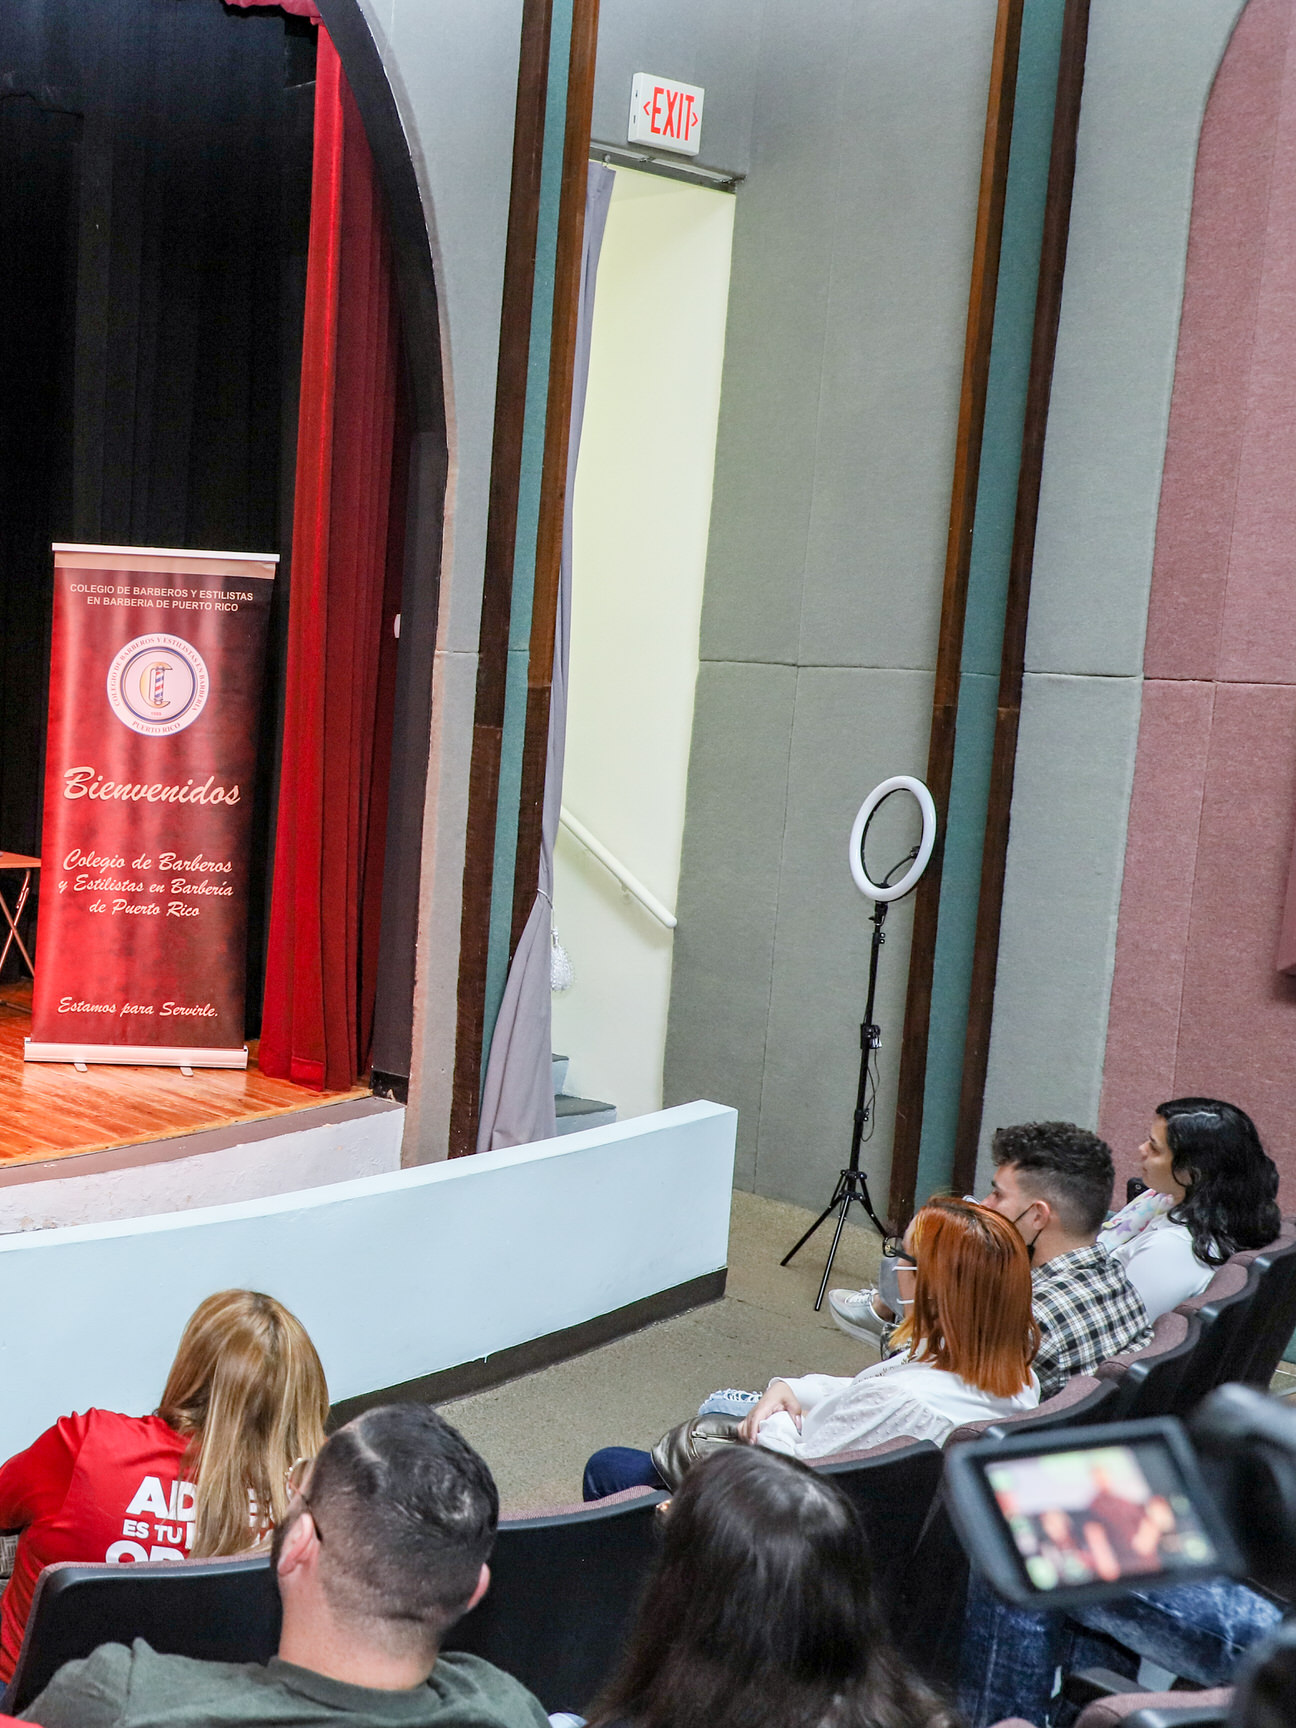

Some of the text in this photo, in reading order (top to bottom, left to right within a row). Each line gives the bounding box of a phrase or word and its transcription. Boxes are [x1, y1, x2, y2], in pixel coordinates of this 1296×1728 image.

[651, 86, 695, 141] EXIT
[70, 583, 254, 601] COLEGIO DE BARBEROS Y ESTILISTAS
[87, 596, 239, 612] EN BARBERIA DE PUERTO RICO
[63, 766, 241, 806] Bienvenidos
[63, 849, 233, 873] Colegio de Barberos
[58, 874, 234, 896] y Estilistas en Barbería
[89, 899, 200, 917] de Puerto Rico
[58, 996, 219, 1018] Estamos para Servirle.
[122, 1519, 150, 1540] ES
[154, 1524, 183, 1544] TU
